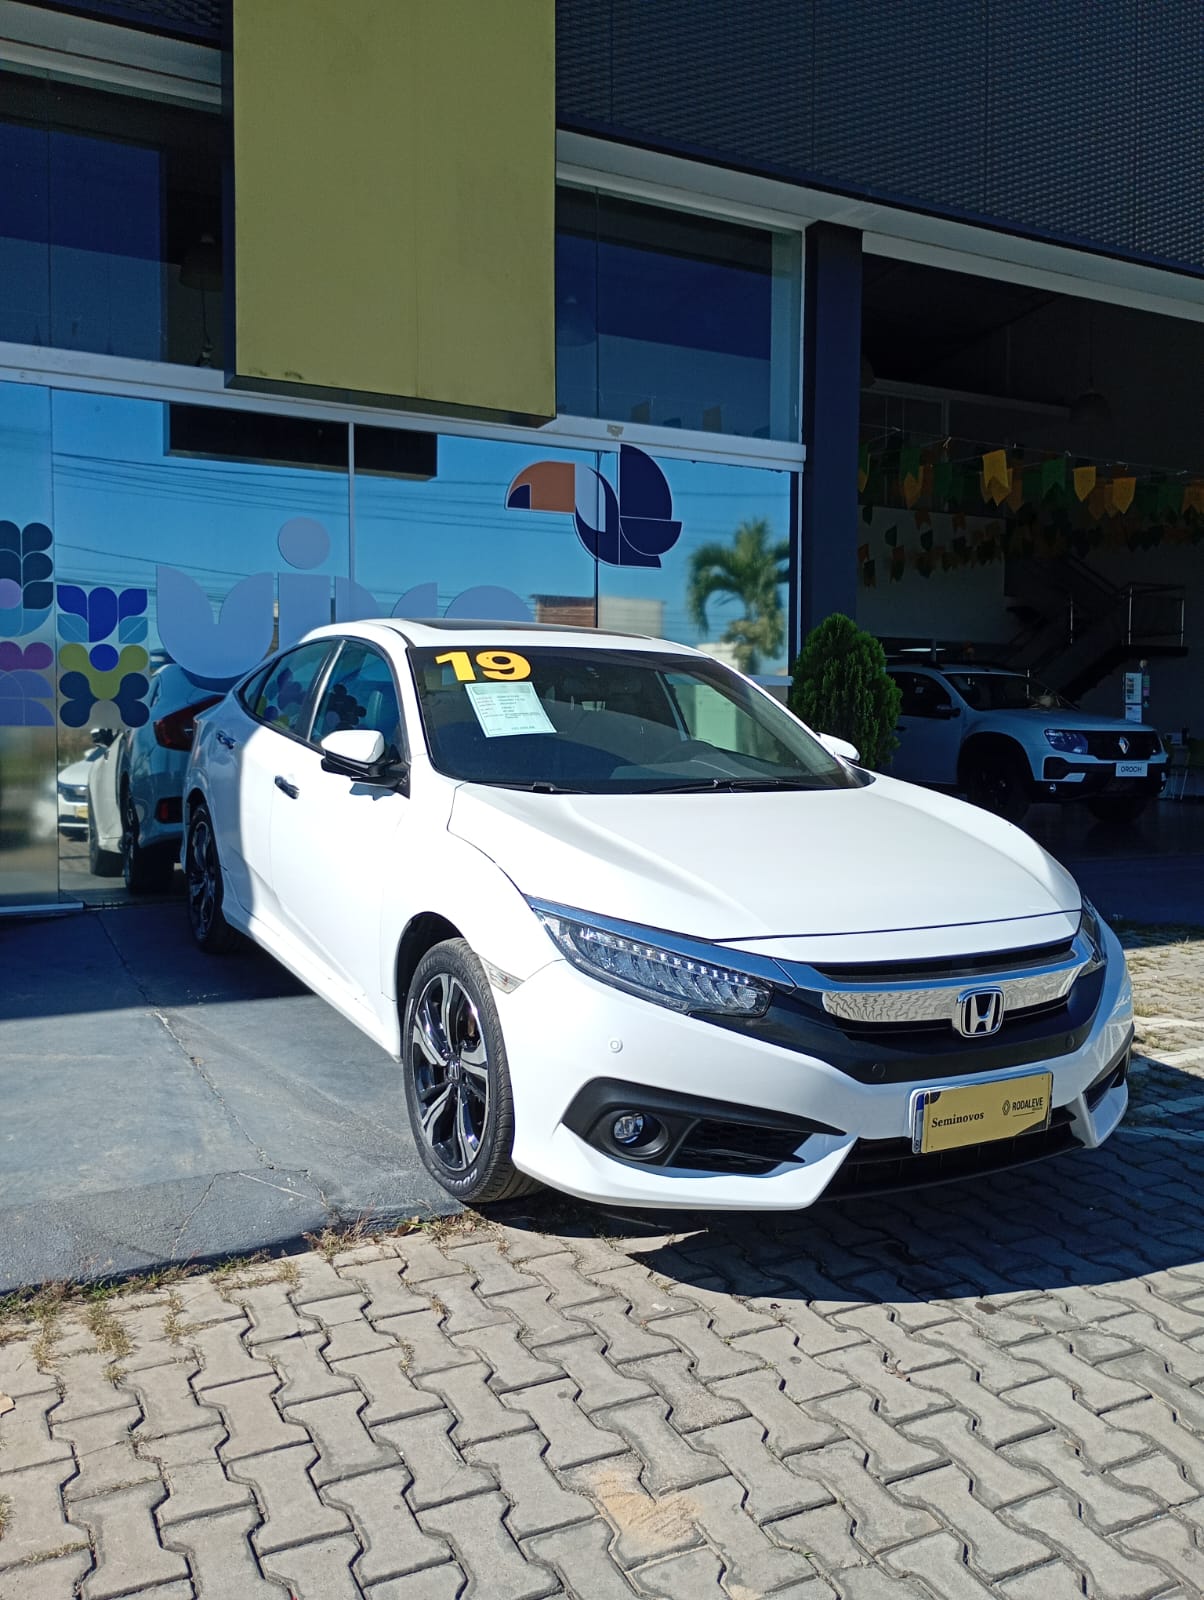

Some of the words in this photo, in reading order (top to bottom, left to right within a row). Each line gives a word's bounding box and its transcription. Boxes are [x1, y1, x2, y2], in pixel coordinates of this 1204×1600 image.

[434, 649, 532, 681] 19
[1012, 1096, 1044, 1111] RODALEVE
[931, 1111, 985, 1128] Seminovos
